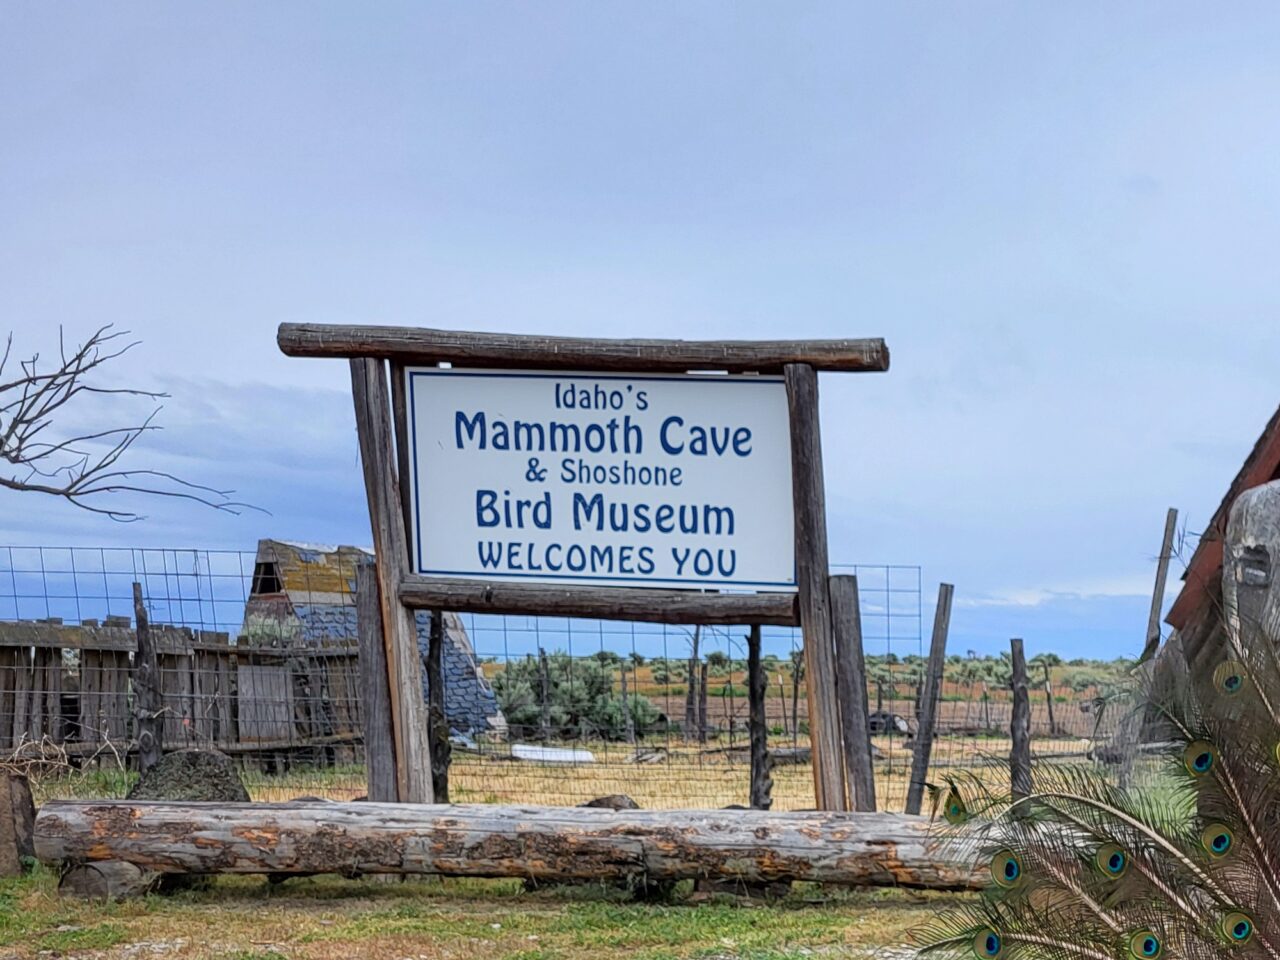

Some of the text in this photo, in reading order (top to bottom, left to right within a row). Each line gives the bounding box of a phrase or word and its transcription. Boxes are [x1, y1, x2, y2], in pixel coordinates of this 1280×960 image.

[554, 382, 649, 412] Idaho's
[454, 410, 753, 458] Mammoth Cave
[525, 457, 683, 487] & Shoshone
[475, 489, 735, 536] Bird Museum
[477, 540, 737, 578] WELCOMES YOU
